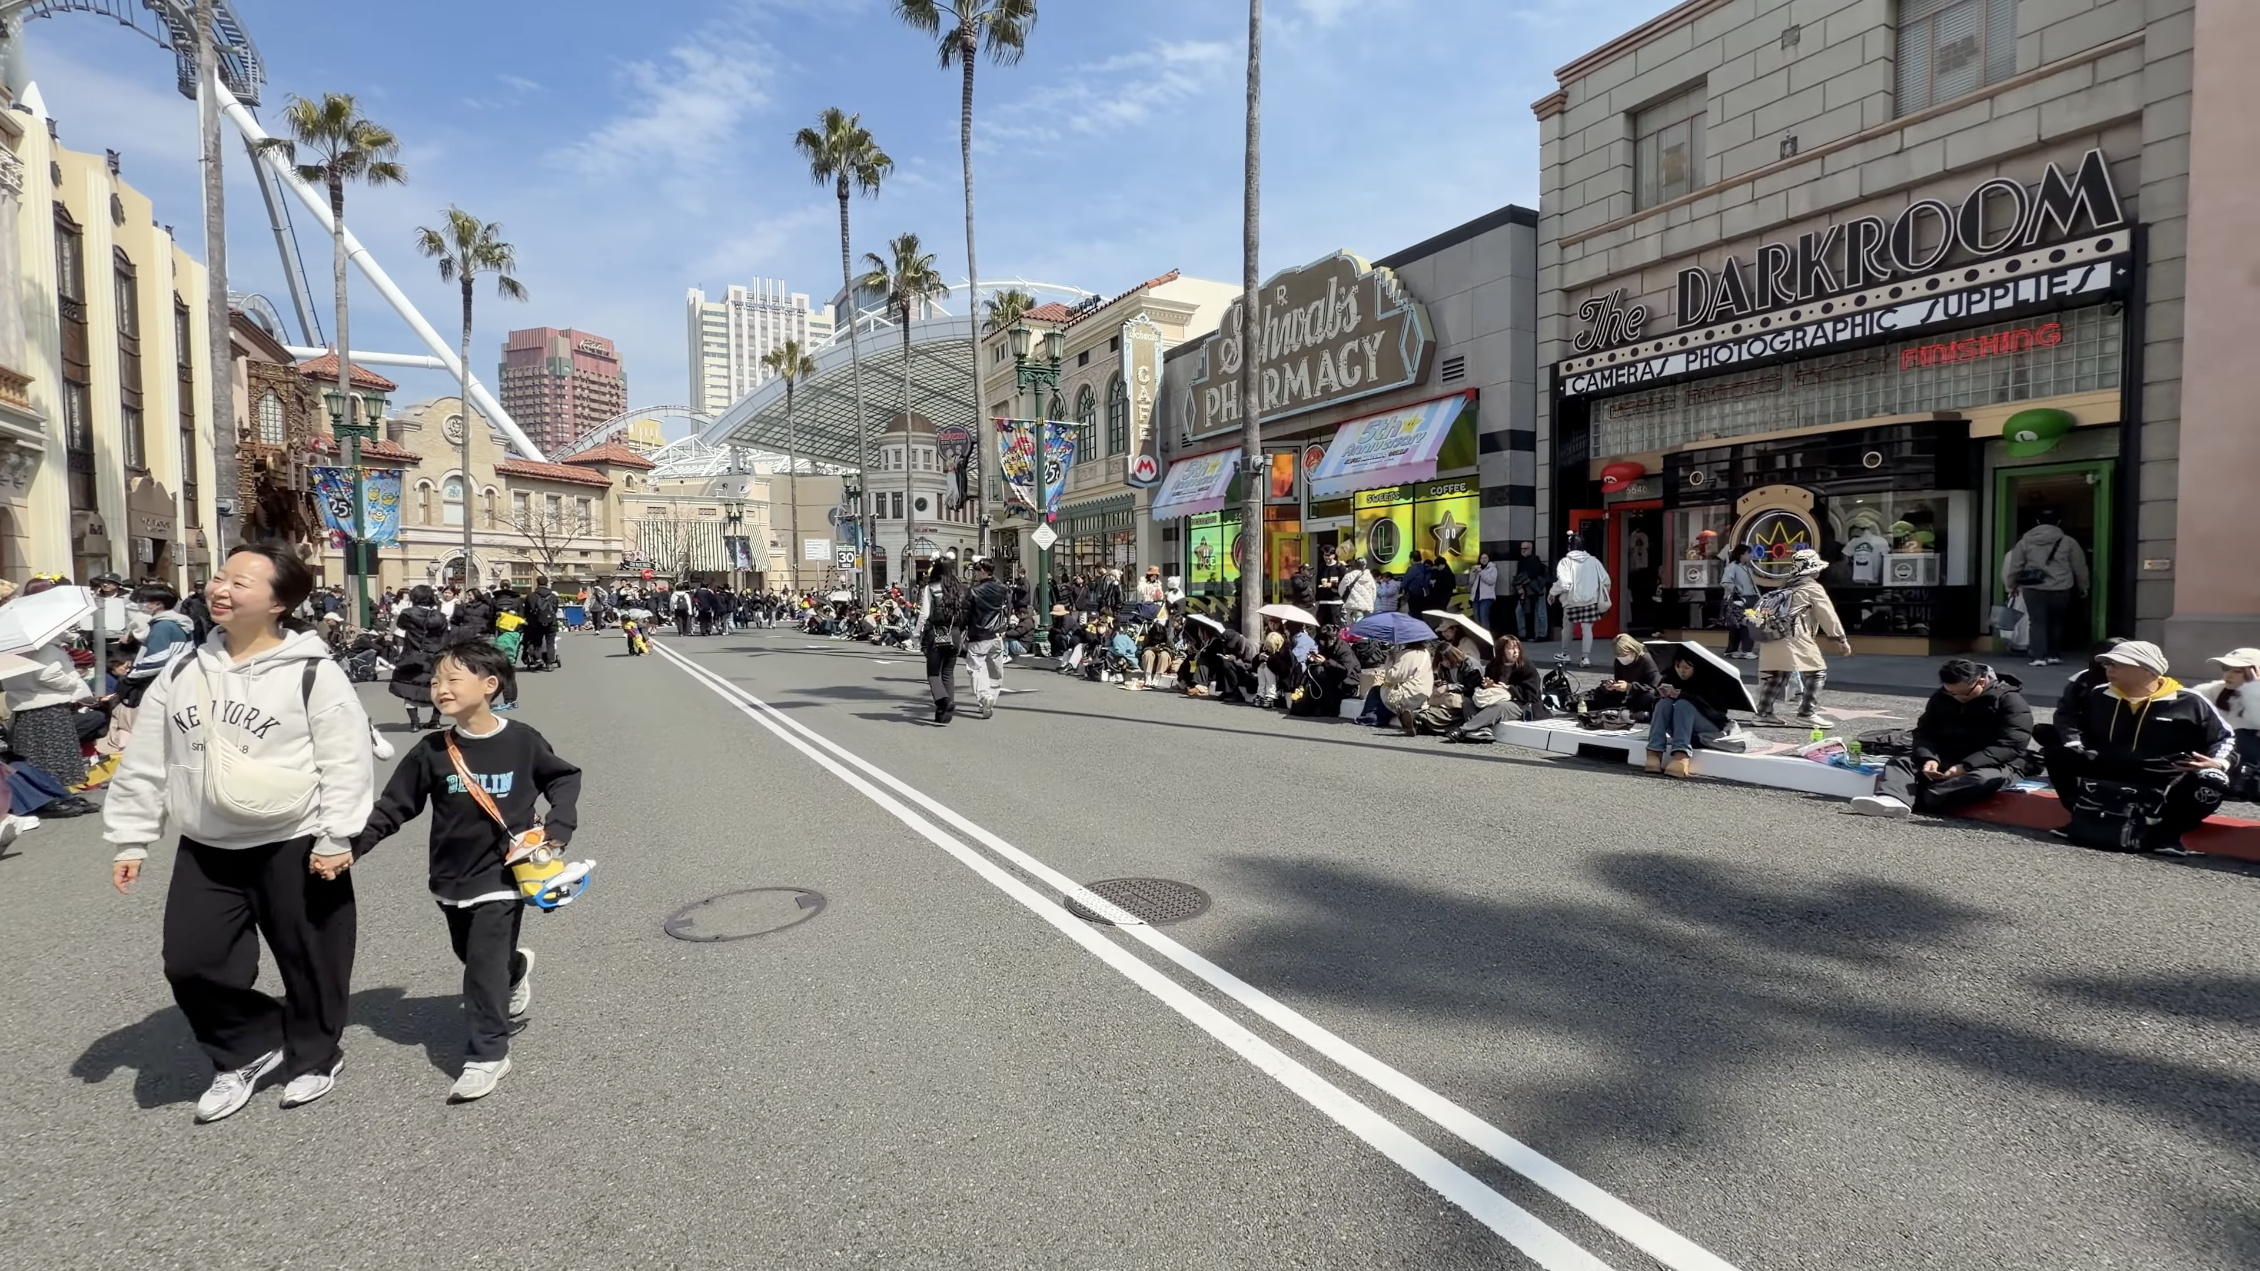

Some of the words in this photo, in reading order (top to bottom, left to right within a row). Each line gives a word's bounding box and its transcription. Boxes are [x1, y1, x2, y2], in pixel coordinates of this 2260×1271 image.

[1573, 288, 1647, 351] The
[1676, 147, 2123, 329] DARKROOM
[1219, 276, 1362, 375] Shwab's
[1572, 357, 1669, 392] CAMERAS
[1685, 308, 1898, 372] PHOTOGRAPHIC
[1920, 264, 2096, 325] SUPPLIES
[1900, 321, 2062, 370] FINISHING
[1204, 330, 1386, 427] PHRMACY
[1358, 415, 1403, 444] 5th
[1366, 491, 1400, 503] SWEETS
[1430, 483, 1467, 495] COFFEE
[838, 552, 855, 563] 30
[222, 700, 281, 739] YORK
